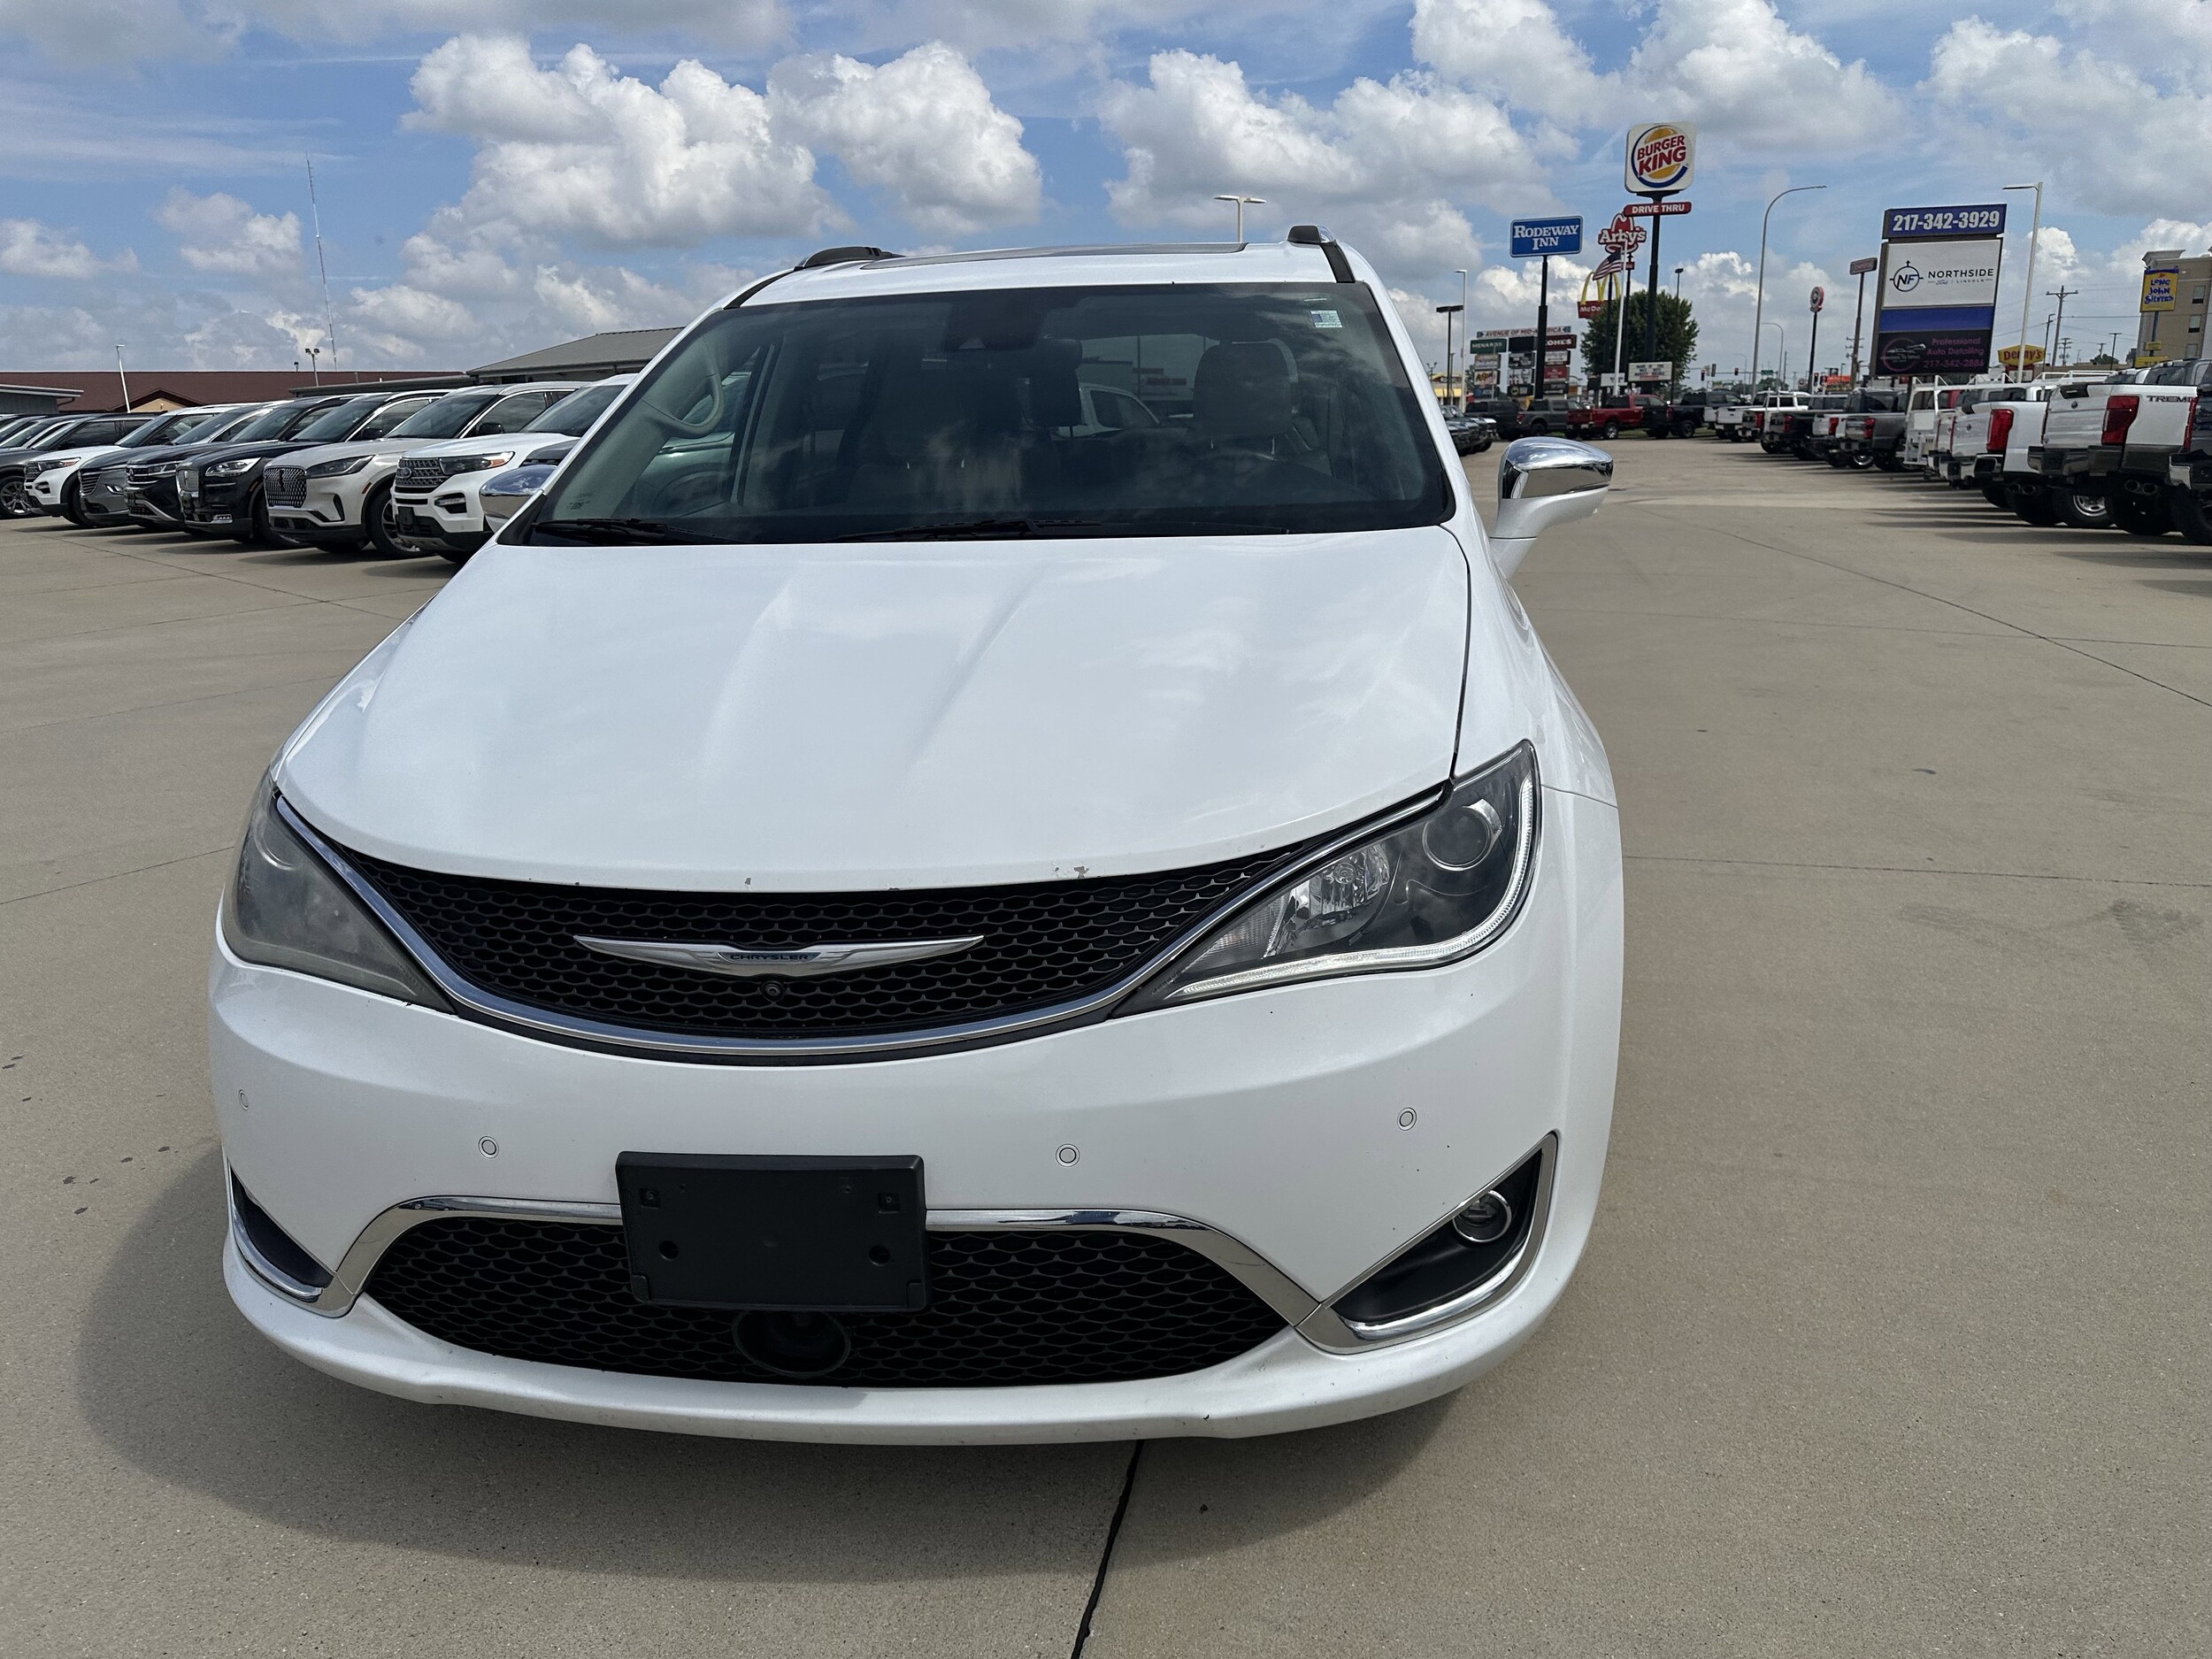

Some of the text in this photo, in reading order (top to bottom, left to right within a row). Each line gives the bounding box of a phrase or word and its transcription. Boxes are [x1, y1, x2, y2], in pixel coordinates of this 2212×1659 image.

[1637, 134, 1685, 160] BURGER
[1639, 146, 1686, 176] KING
[1632, 204, 1659, 213] DRIVE
[1893, 211, 2001, 231] 217-342-3929
[1513, 224, 1579, 238] RODEWAY
[1599, 227, 1646, 245] Arby's
[1532, 236, 1559, 250] INN
[1928, 268, 1993, 279] NORTHSIDE
[2003, 349, 2043, 360] Deny's
